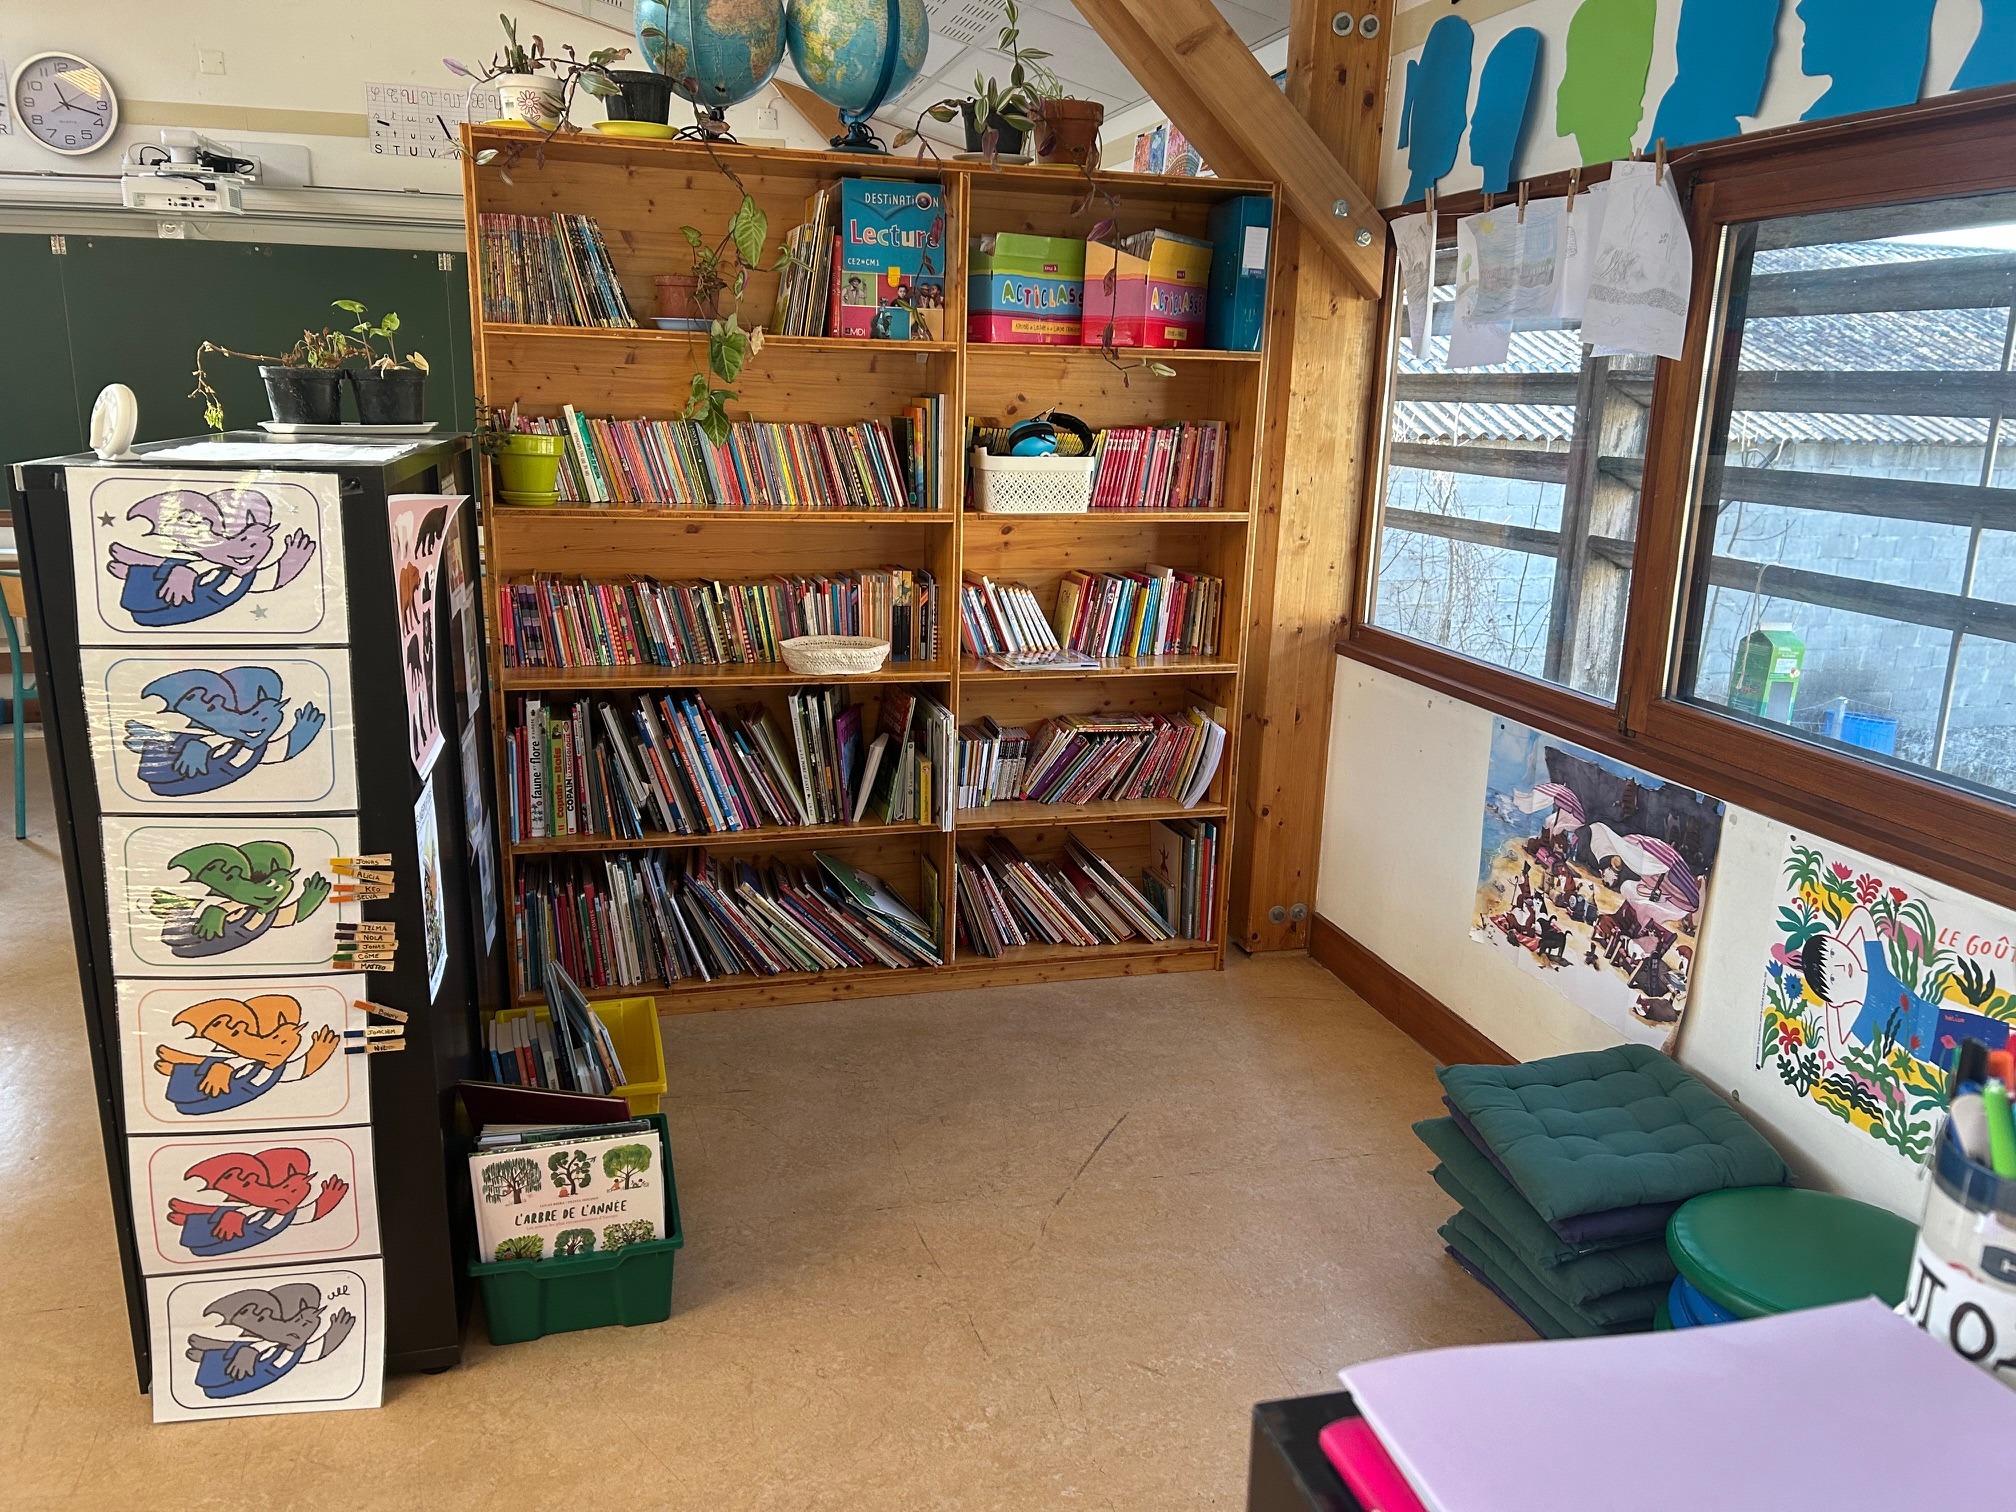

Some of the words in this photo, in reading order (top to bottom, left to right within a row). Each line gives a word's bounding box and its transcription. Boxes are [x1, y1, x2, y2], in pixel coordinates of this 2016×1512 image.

[40, 67, 49, 77] 11
[54, 62, 68, 73] 12
[26, 80, 43, 91] 10
[23, 97, 35, 107] 9
[96, 101, 108, 111] 3
[31, 114, 44, 125] 8
[93, 117, 104, 127] 4
[45, 128, 57, 138] 7
[80, 129, 93, 140] 5
[64, 134, 76, 145] 6
[850, 218, 940, 248] Lecture
[530, 741, 541, 764] flore
[531, 772, 543, 799] faune
[357, 871, 380, 881] ALICIA
[1937, 927, 1961, 948] LE
[515, 1209, 558, 1226] L'ARBRE
[562, 1206, 576, 1219] DE
[581, 1199, 627, 1217] L'ANNÉE
